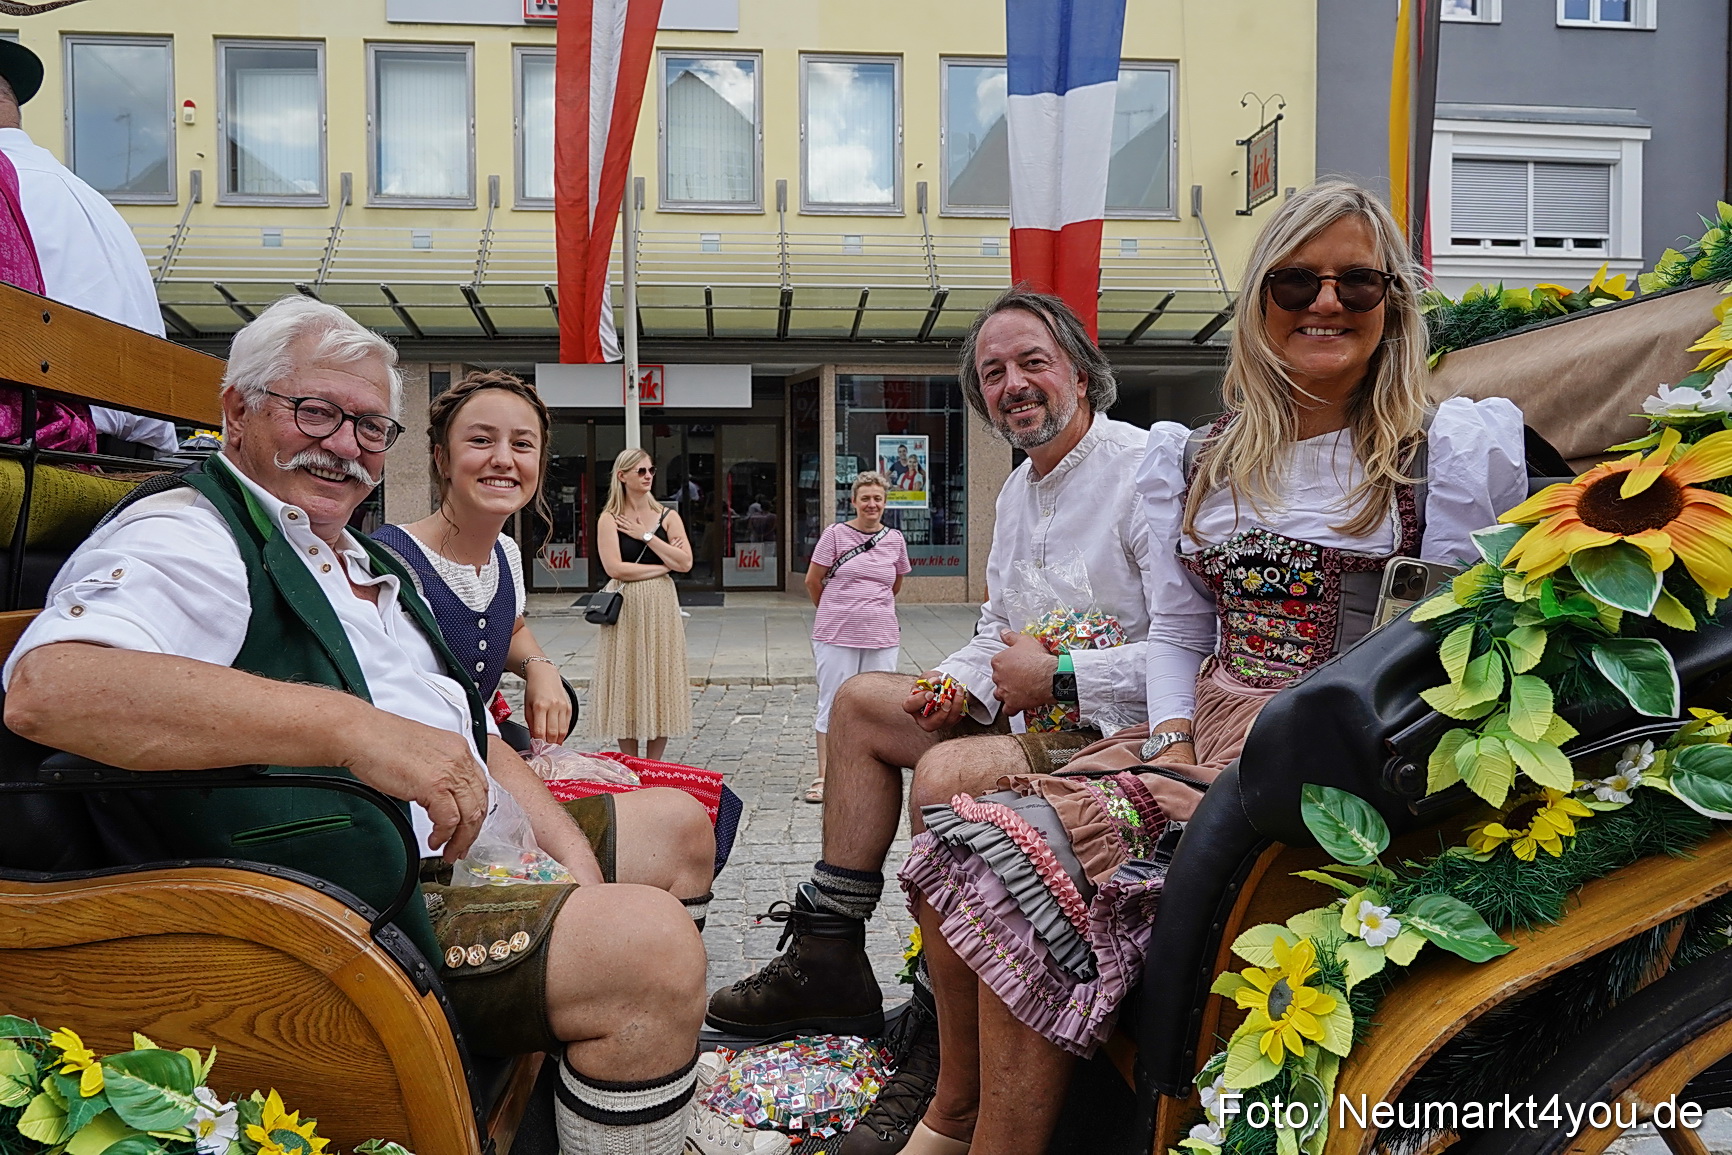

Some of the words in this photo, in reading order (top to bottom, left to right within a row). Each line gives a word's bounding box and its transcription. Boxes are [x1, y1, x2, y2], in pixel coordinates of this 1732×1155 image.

[1253, 145, 1271, 192] kik
[549, 547, 572, 568] kik
[739, 548, 761, 568] kik
[909, 556, 960, 566] ww.kik.de
